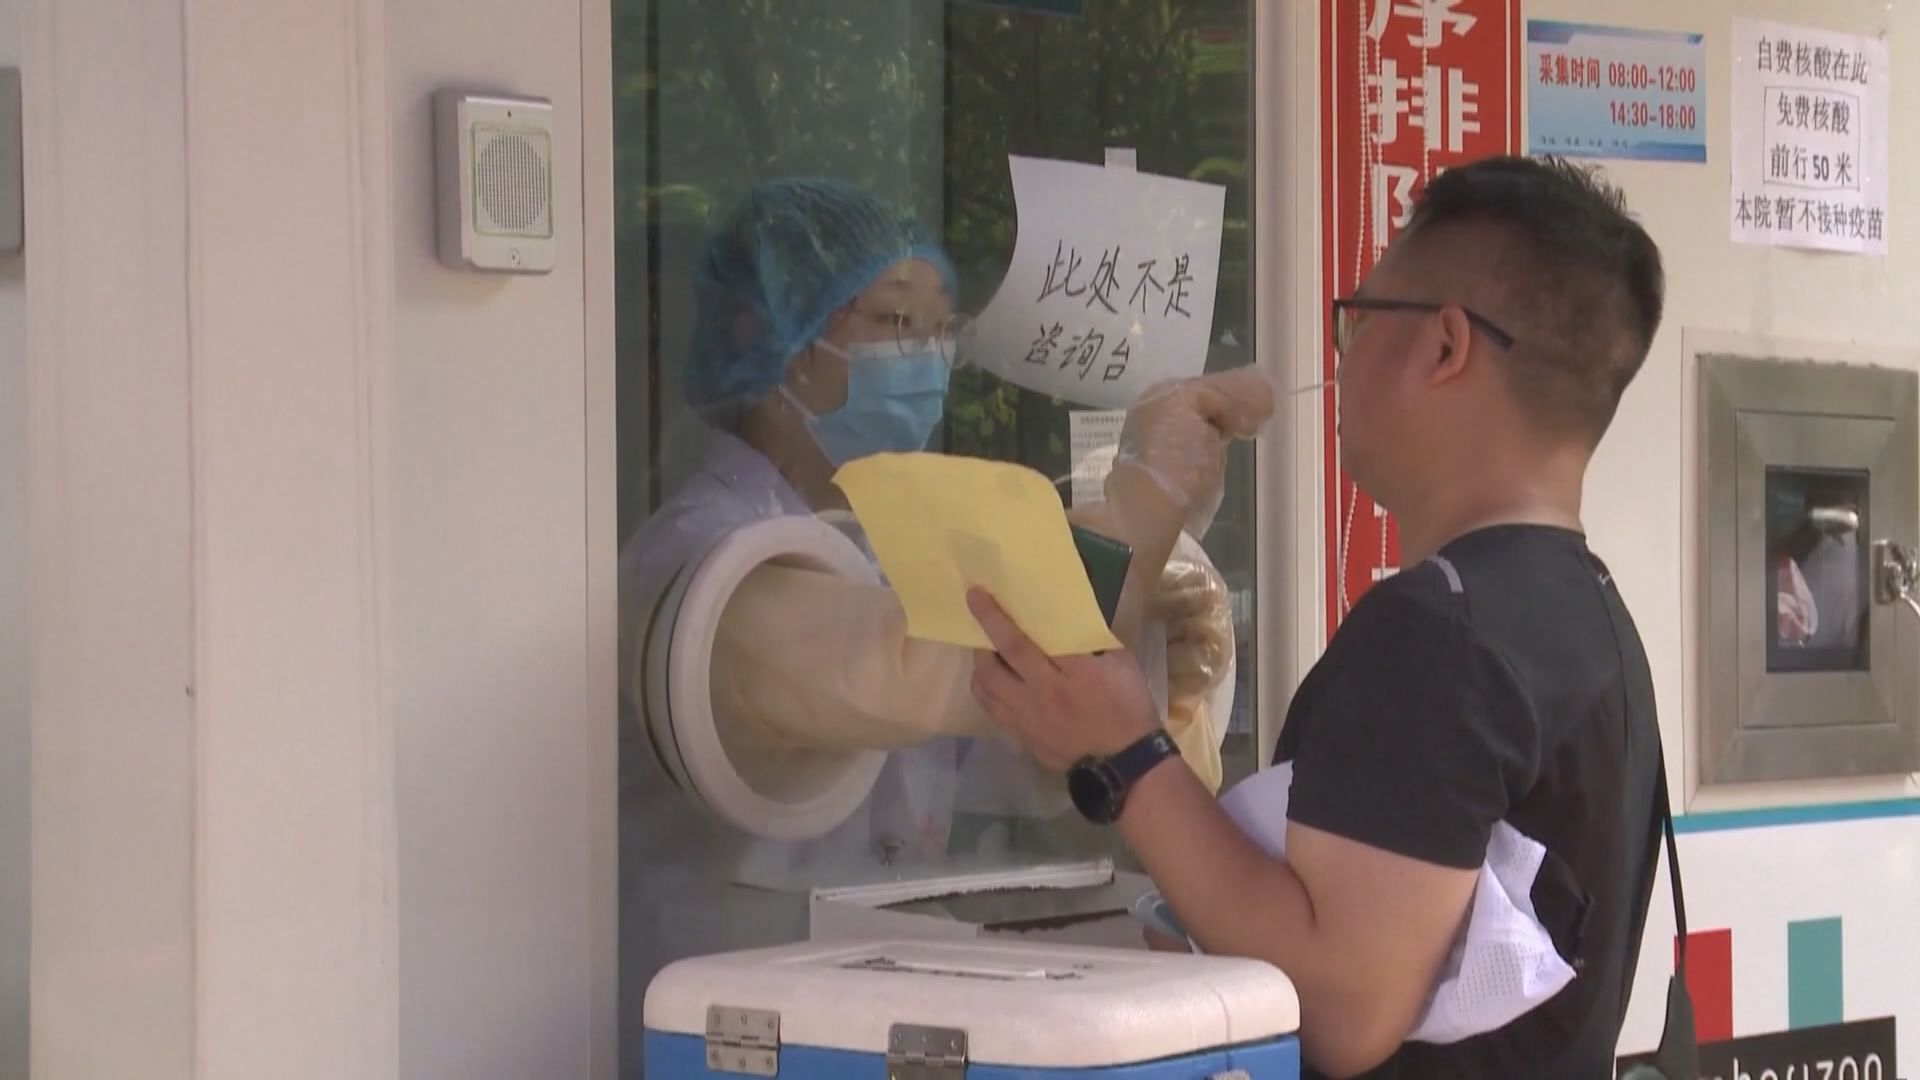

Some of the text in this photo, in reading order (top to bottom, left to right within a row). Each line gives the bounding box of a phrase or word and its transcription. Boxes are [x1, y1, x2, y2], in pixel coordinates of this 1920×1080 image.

[1539, 54, 1696, 93] 采集时间 08:00-12:00
[1757, 34, 1868, 85] 自费核酸在此
[1609, 100, 1696, 130] 14:30-18:00
[1777, 91, 1850, 136] 免费核酸
[1735, 192, 1884, 241] 本院暂不接种疫苗
[1037, 237, 1195, 319] 此处不是
[1024, 320, 1130, 383] 咨询台
